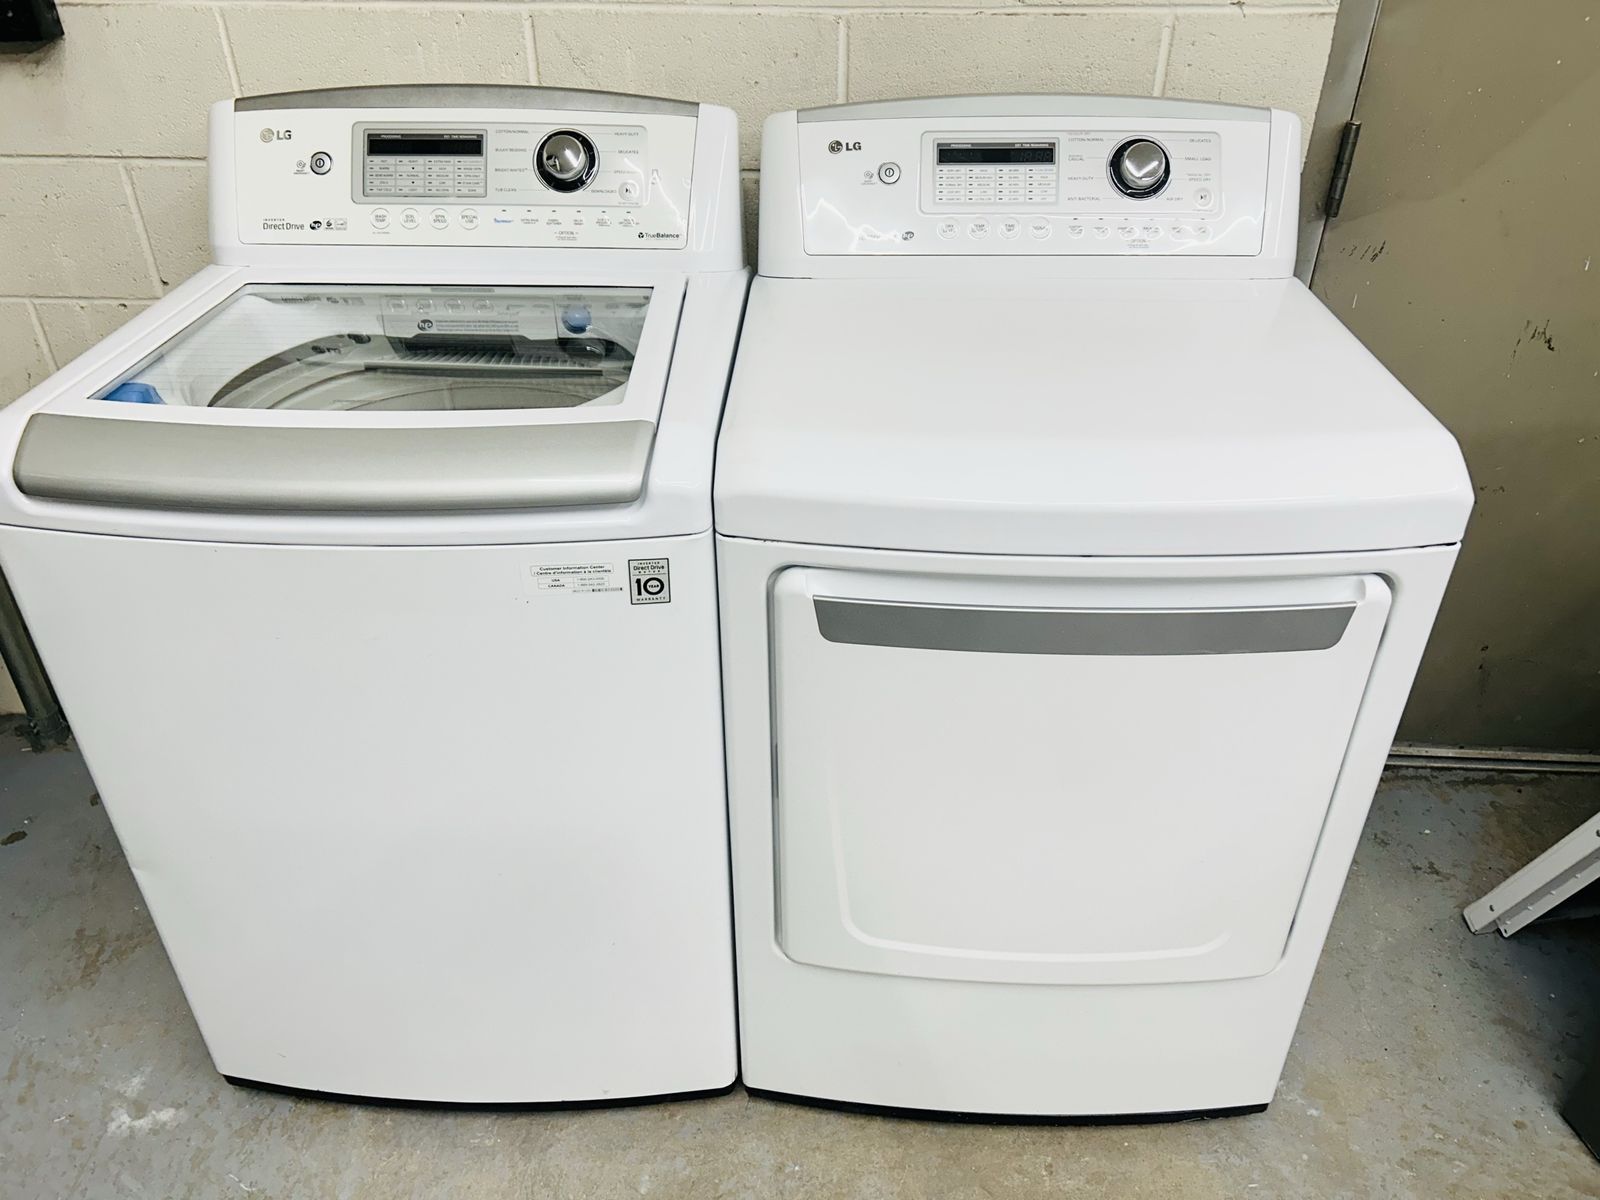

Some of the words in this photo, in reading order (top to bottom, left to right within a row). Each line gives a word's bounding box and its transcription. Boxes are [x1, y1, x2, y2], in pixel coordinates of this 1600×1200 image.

[276, 130, 292, 140] LG
[845, 142, 862, 151] LG
[262, 222, 285, 230] Direct
[285, 222, 305, 230] Drive
[635, 577, 665, 596] 10
